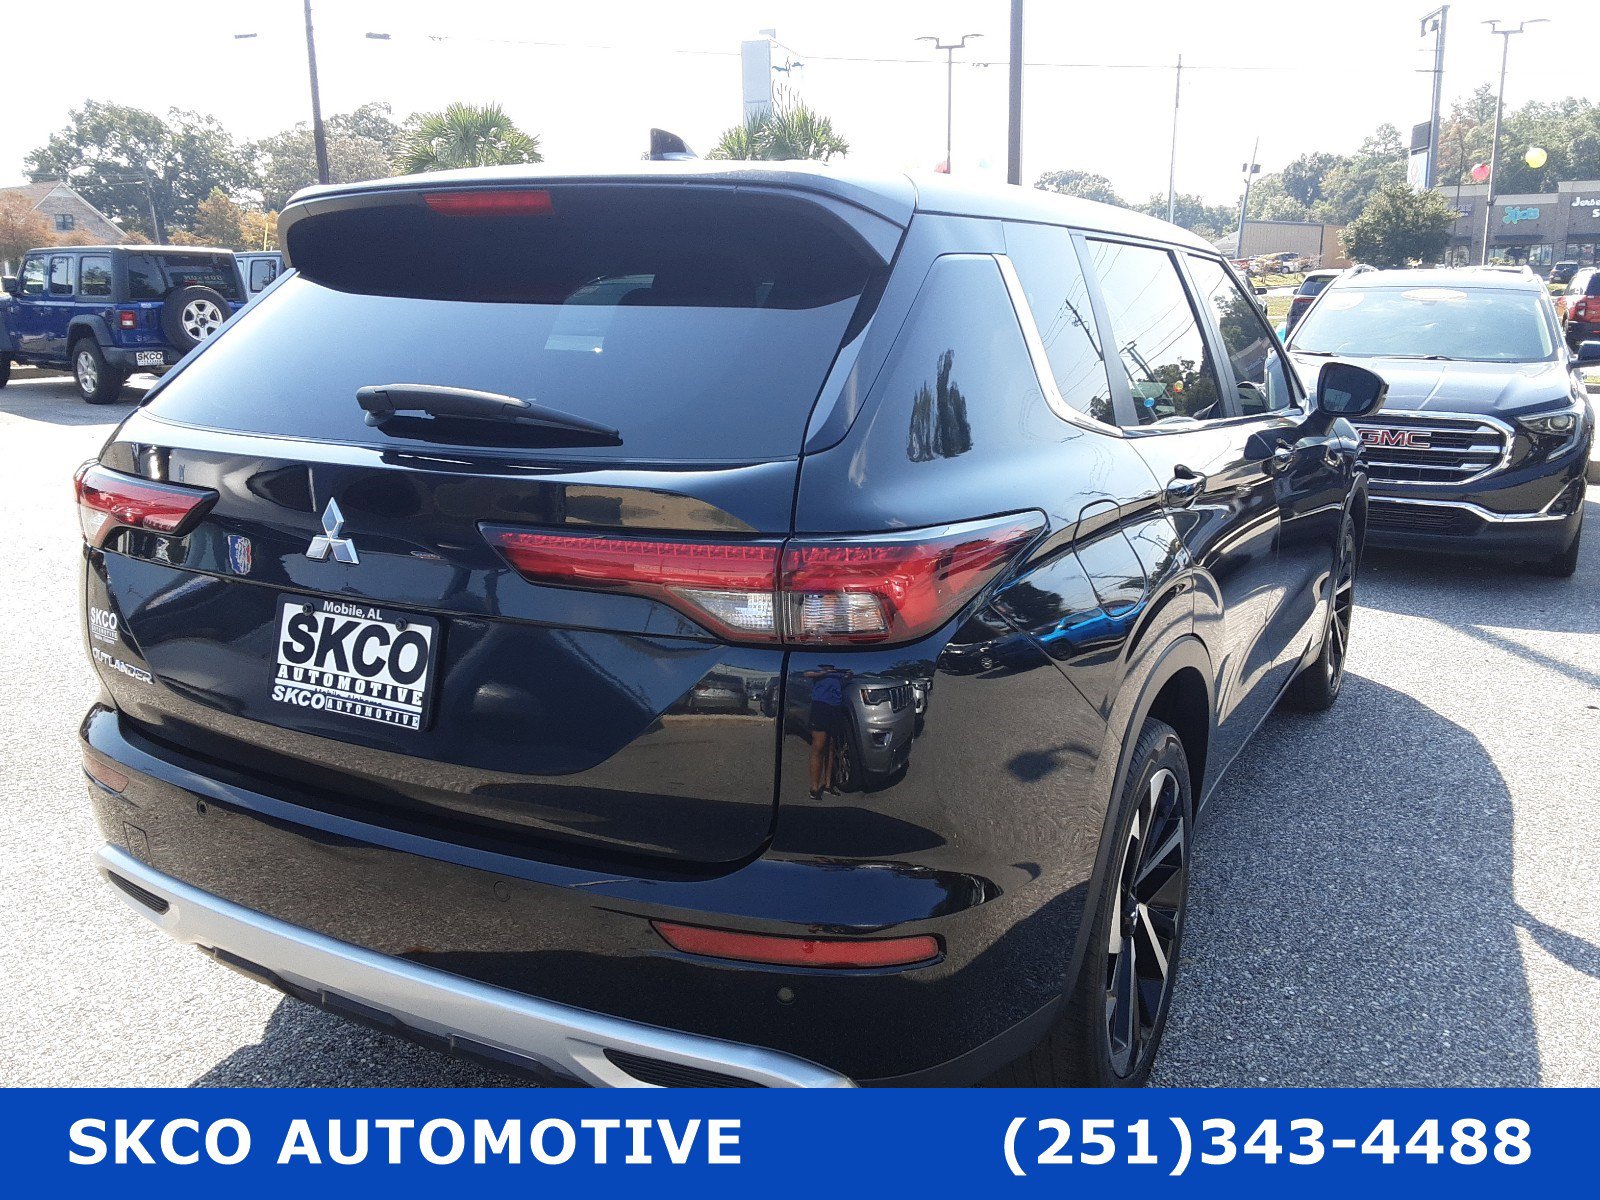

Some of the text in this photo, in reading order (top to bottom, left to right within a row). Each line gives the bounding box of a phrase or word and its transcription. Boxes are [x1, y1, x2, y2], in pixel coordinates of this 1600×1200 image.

[137, 352, 163, 361] SKCO
[1357, 429, 1432, 448] GMC
[90, 606, 118, 630] SKCO
[322, 600, 383, 621] Mobile, AL
[282, 612, 429, 685] SKCO
[93, 647, 154, 685] OUTLANDER
[277, 664, 423, 706] AUTOMOTIVE
[271, 685, 326, 710] SKCO
[326, 697, 420, 728] AUTOMOTIVE
